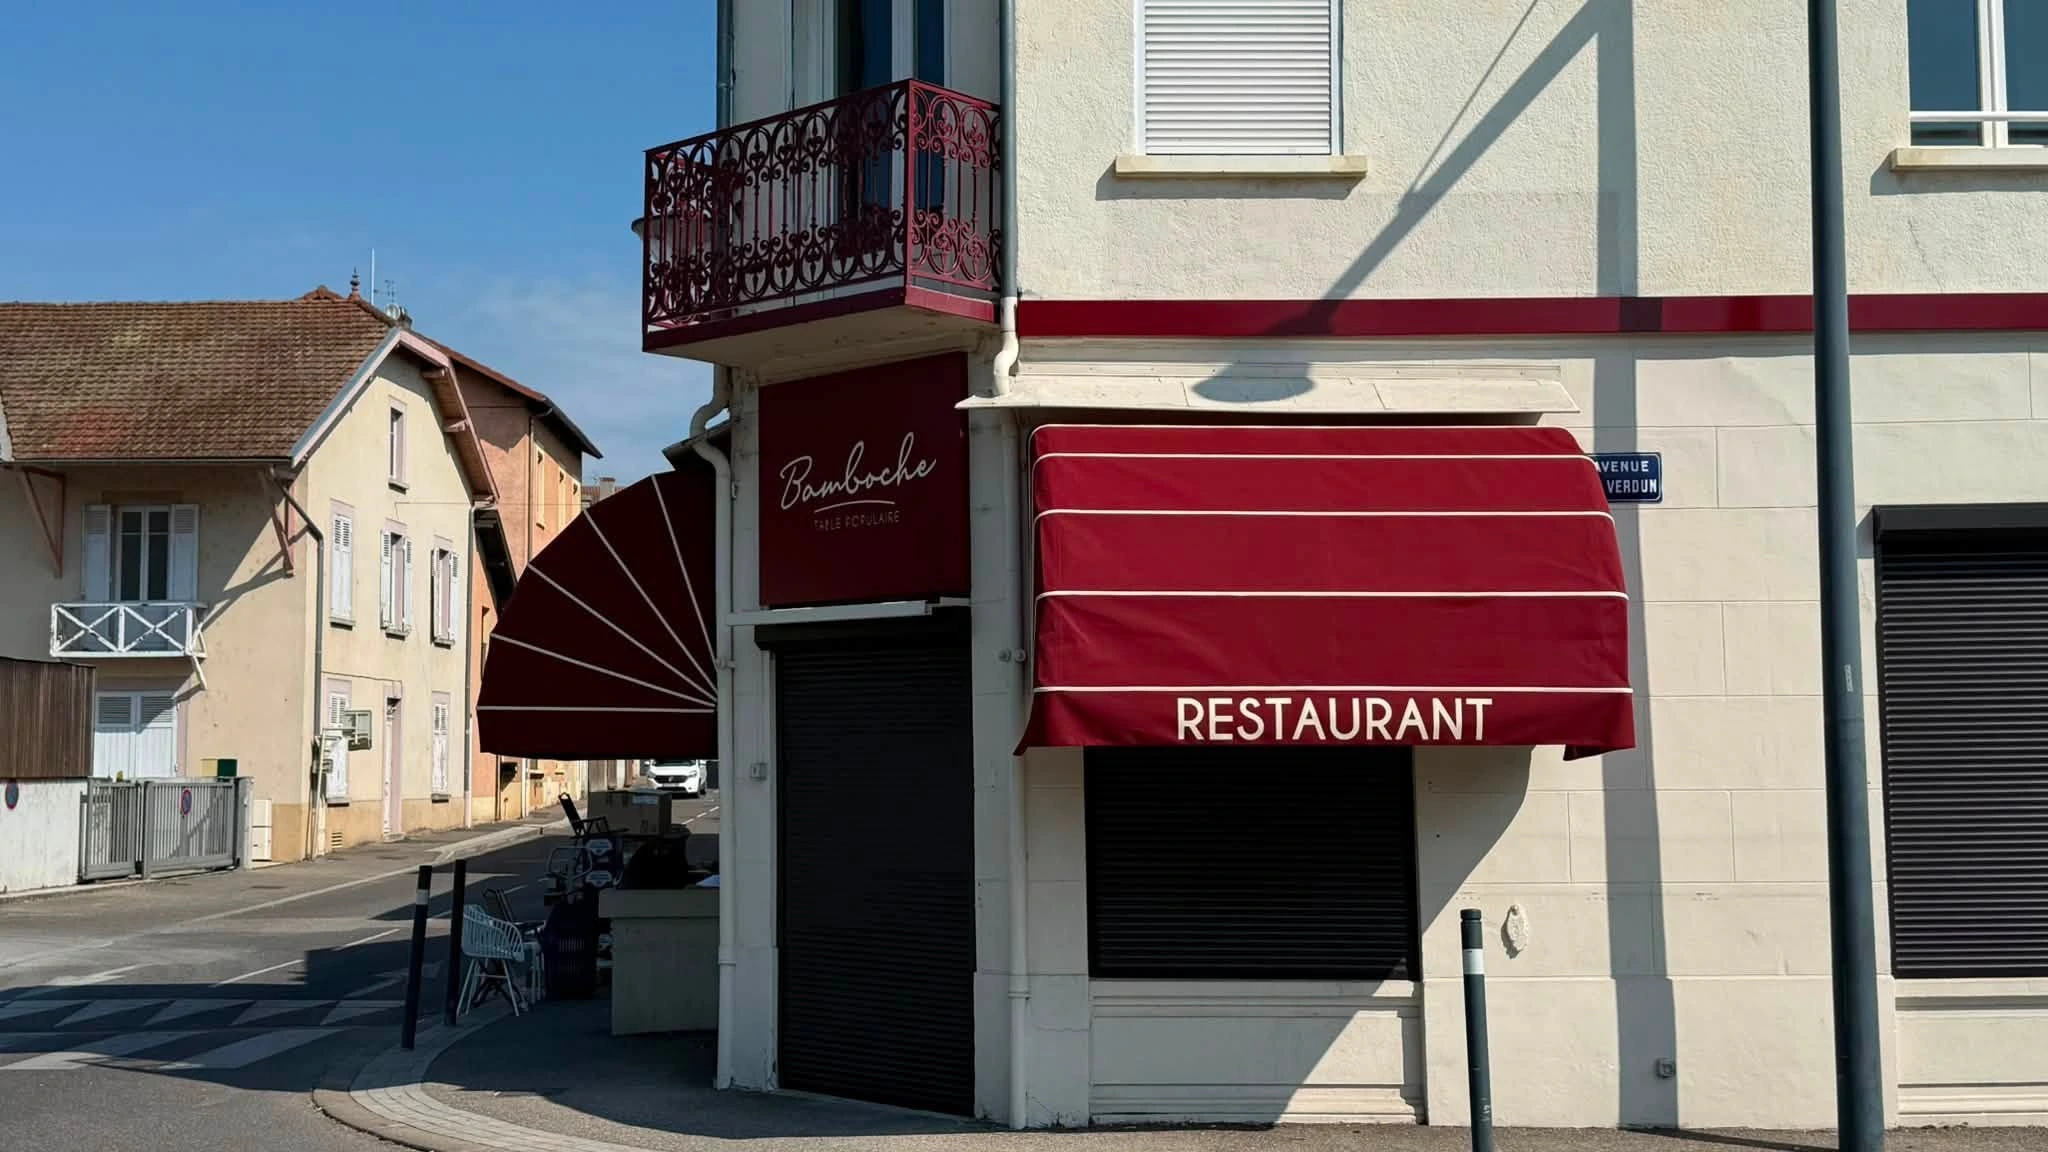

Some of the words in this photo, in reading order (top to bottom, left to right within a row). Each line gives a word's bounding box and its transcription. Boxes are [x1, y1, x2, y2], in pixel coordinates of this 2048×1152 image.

[780, 431, 936, 510] Bamboche
[1606, 479, 1657, 493] VERDUN
[845, 510, 900, 528] POPULAIRE
[1177, 697, 1493, 741] RESTAURANT
